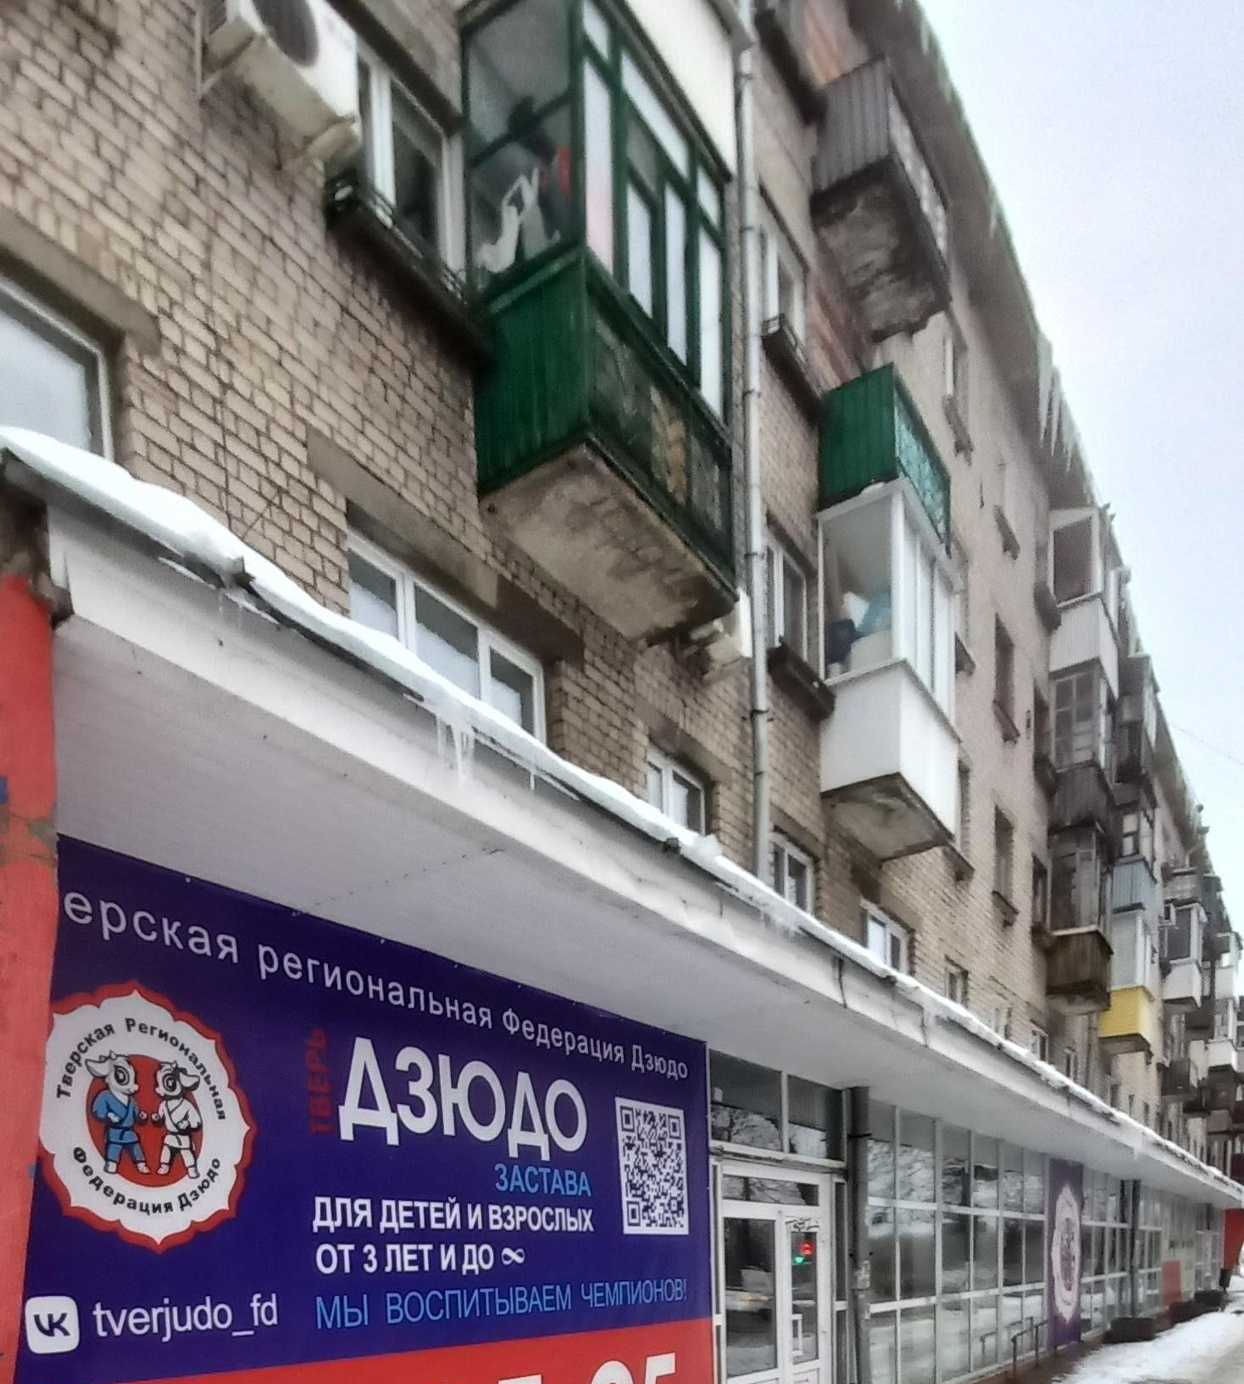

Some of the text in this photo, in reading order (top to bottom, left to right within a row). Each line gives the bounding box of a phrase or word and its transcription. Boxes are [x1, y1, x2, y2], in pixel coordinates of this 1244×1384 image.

[258, 943, 492, 1029] региональная
[502, 1007, 625, 1063] Федерация
[631, 1044, 689, 1080] Дзюдо
[56, 1017, 226, 1120] Тверская Региональная
[305, 1027, 336, 1137] ТВЕРЬ
[338, 1036, 588, 1161] ДЗЮДО
[73, 1147, 221, 1216] Федерация Дзюдо
[494, 1163, 592, 1197] ЗАСТАВА
[313, 1196, 594, 1233] ДЛЯ ДЕТЕЙ И ВЗРОСЛЫХ
[315, 1243, 354, 1274] ОТ
[363, 1245, 378, 1273] 3
[385, 1243, 434, 1273] ЛЕТ
[440, 1244, 456, 1272] И
[462, 1243, 495, 1275] ДО
[92, 1293, 279, 1342] tverjudo_fd
[315, 1278, 688, 1330] МЫ ВОСПИТЫВАЕМ ЧЕМПИОНОВ!
